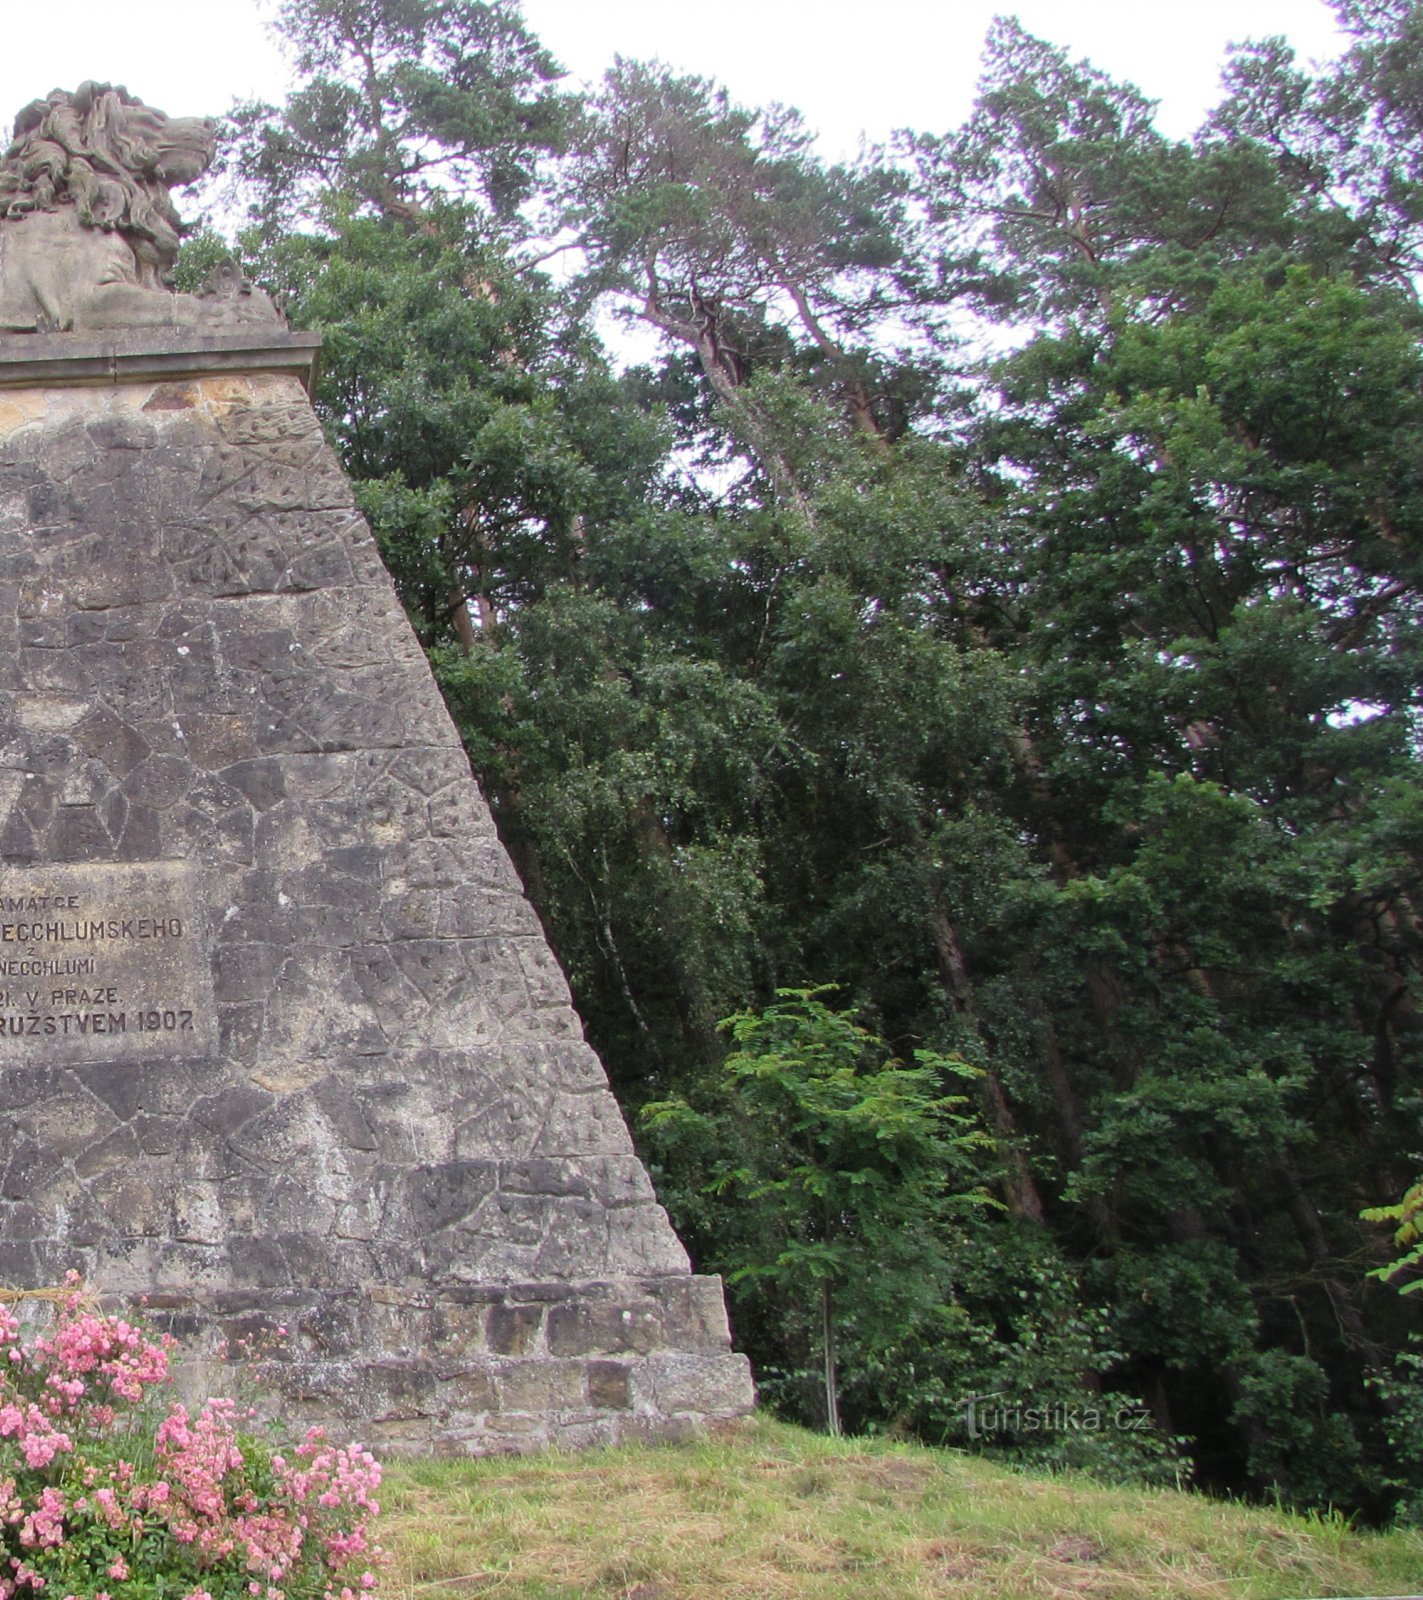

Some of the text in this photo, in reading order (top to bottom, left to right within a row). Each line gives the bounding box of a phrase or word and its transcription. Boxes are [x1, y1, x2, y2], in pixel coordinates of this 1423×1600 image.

[26, 991, 39, 1007] V
[51, 988, 124, 1006] PRAZE.
[139, 1010, 194, 1032] 1907.
